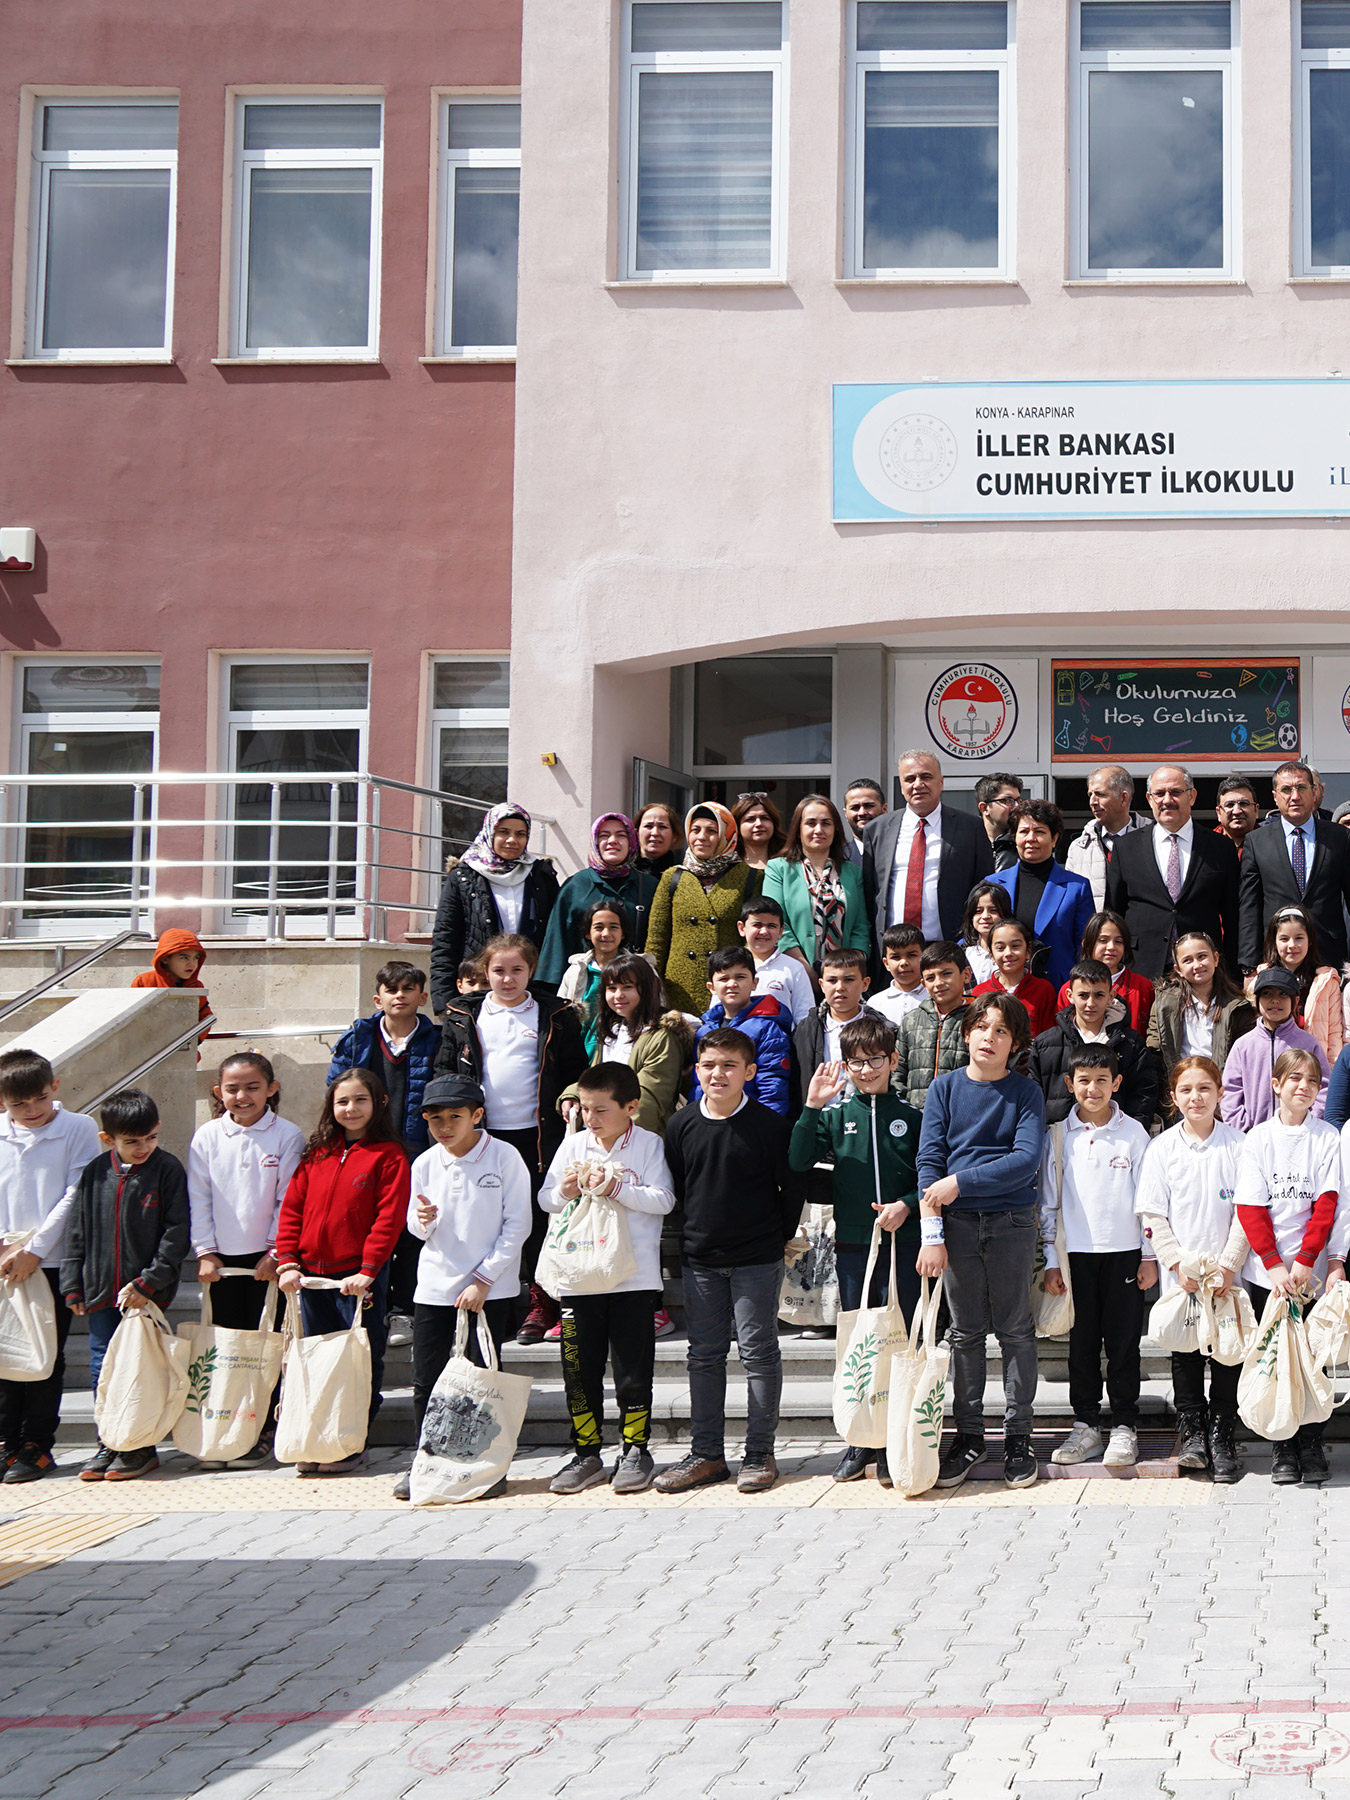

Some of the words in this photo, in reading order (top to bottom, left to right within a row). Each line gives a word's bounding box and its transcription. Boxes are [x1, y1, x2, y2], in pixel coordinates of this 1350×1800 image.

[975, 407, 1009, 419] KONYA
[1017, 406, 1075, 418] KARAPINAR
[976, 429, 1050, 457] İLLER
[1059, 432, 1175, 456] BANKASI
[976, 466, 1152, 496] CUMHURİYET
[1161, 465, 1294, 493] İLKOKULU
[931, 666, 978, 706] CUMHURİYET
[981, 667, 1012, 706] İLKOKULU
[1115, 682, 1237, 700] Okulumuza
[1104, 707, 1145, 727] Hoş
[1153, 706, 1248, 724] Geldiniz
[946, 741, 998, 757] KARAPINAR
[561, 1307, 577, 1339] WIN
